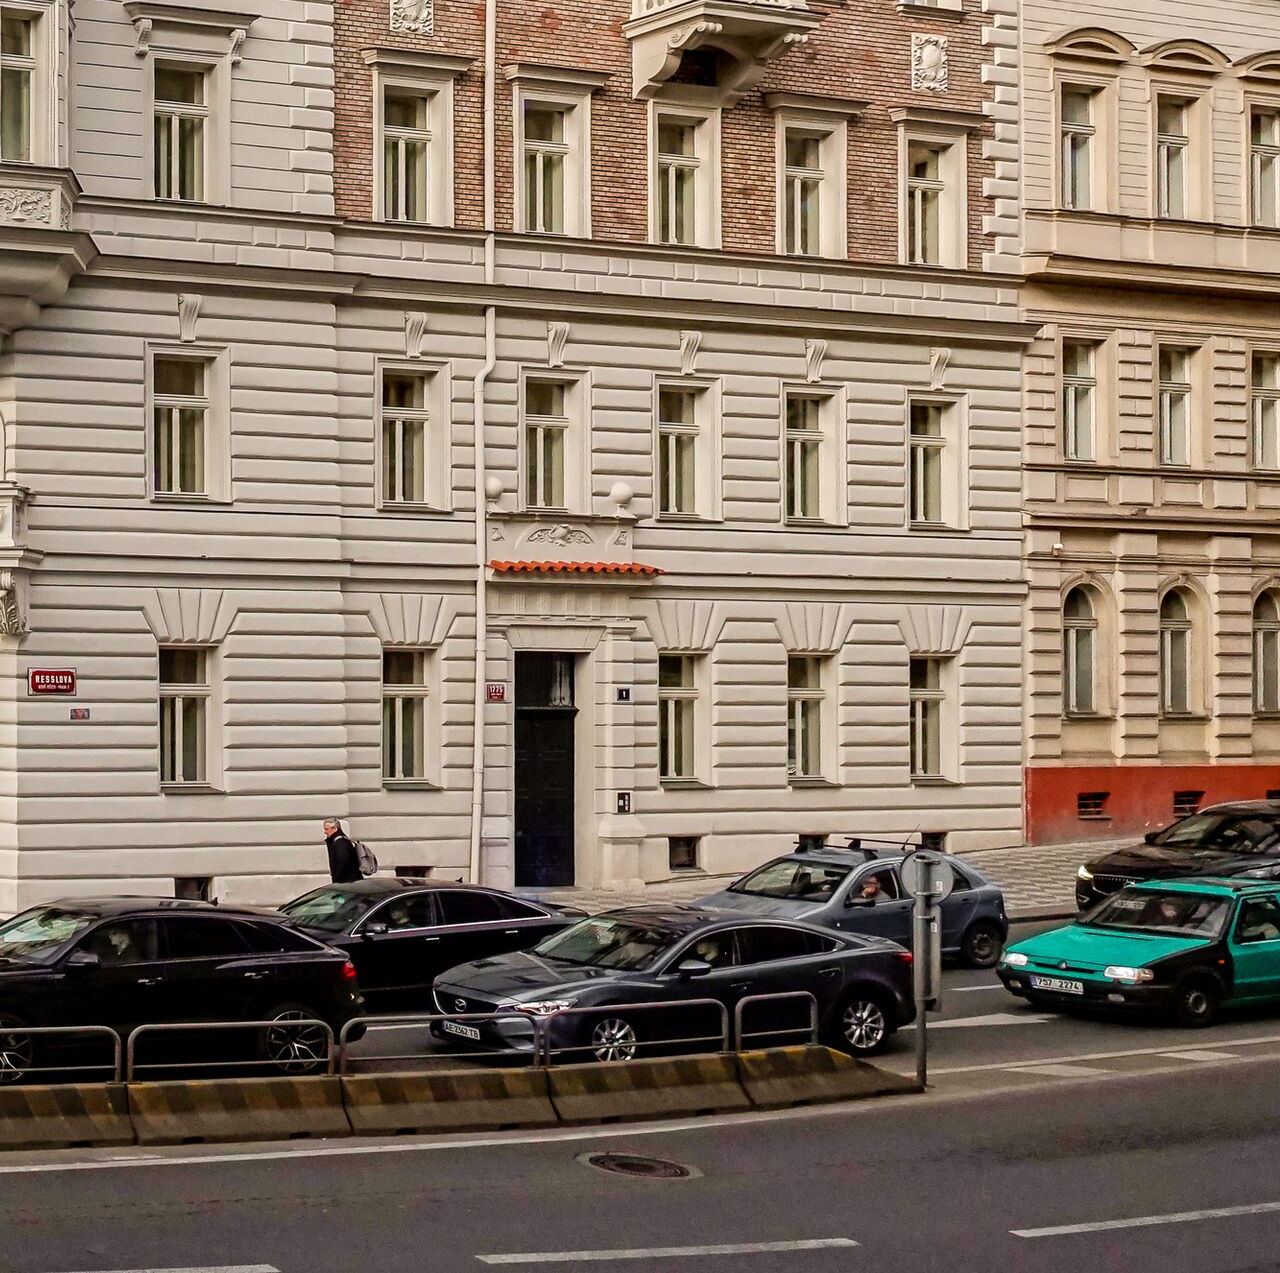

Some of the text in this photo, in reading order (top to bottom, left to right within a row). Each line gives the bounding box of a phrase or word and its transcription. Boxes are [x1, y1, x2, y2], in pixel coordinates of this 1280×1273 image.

[35, 675, 72, 684] RESSLOVA
[489, 685, 503, 693] 1775
[622, 690, 626, 698] 1
